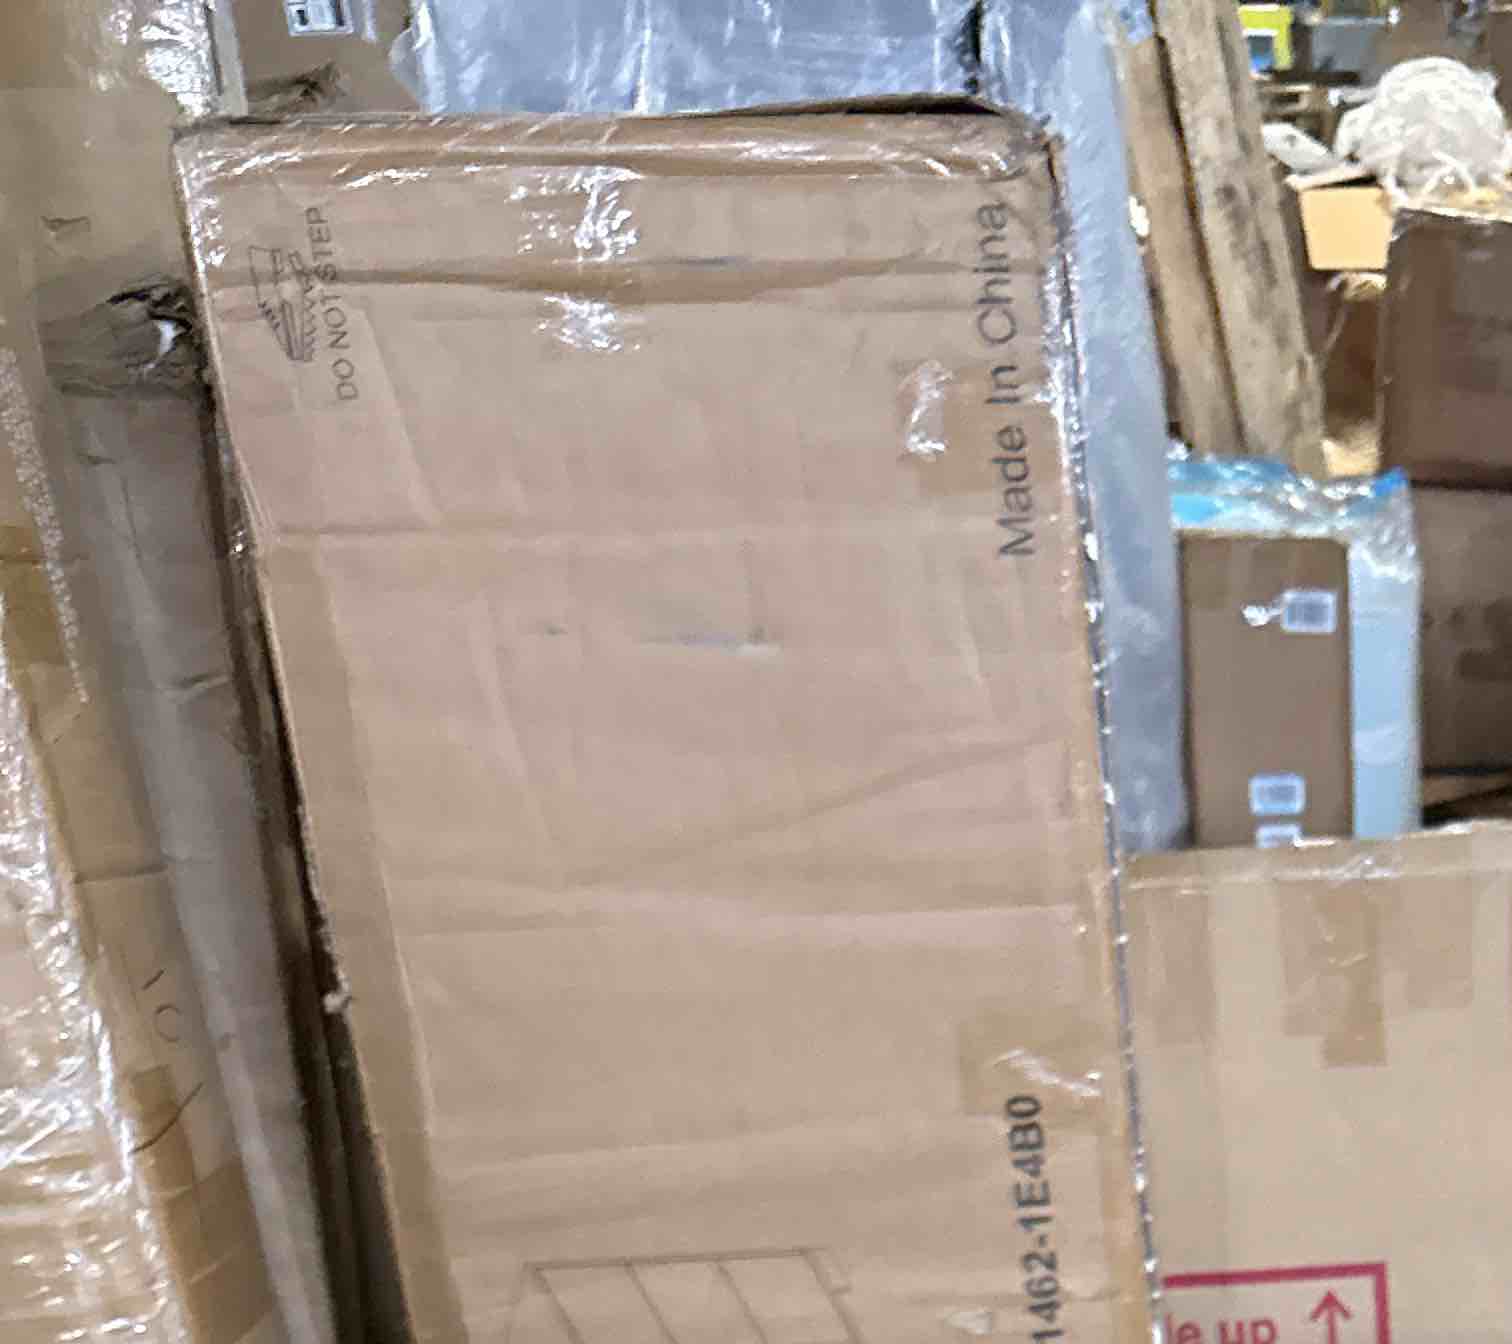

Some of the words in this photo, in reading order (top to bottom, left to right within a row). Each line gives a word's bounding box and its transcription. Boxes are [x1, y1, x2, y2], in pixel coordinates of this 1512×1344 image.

[305, 207, 337, 284] STEP
[972, 202, 1018, 344] China
[320, 290, 350, 350] NOT
[331, 358, 359, 400] DO
[987, 364, 1022, 405] In
[991, 426, 1036, 557] Made
